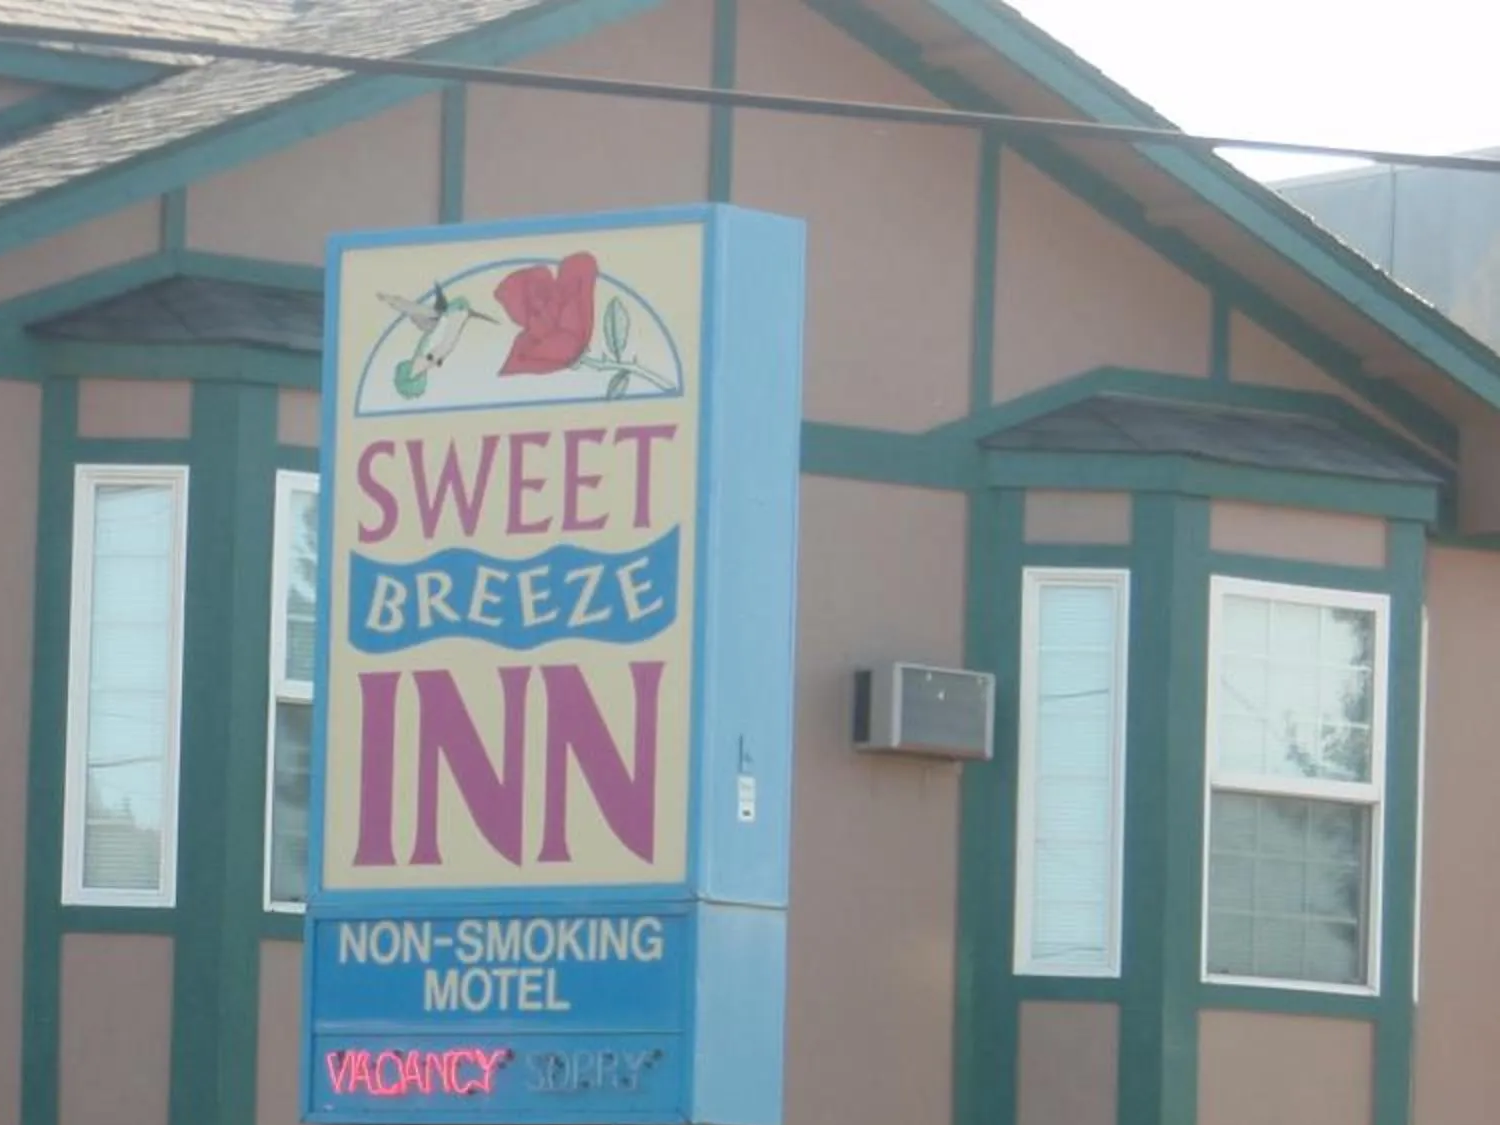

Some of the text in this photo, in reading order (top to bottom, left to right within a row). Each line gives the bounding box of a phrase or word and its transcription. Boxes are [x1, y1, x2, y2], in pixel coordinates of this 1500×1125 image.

[357, 424, 678, 544] SWEET
[365, 556, 664, 632] BREEZE
[352, 661, 666, 868] INN
[338, 916, 665, 965] NON-SMOKING
[423, 967, 571, 1011] MOTEL
[326, 1048, 652, 1095] VACANCY SORRY
